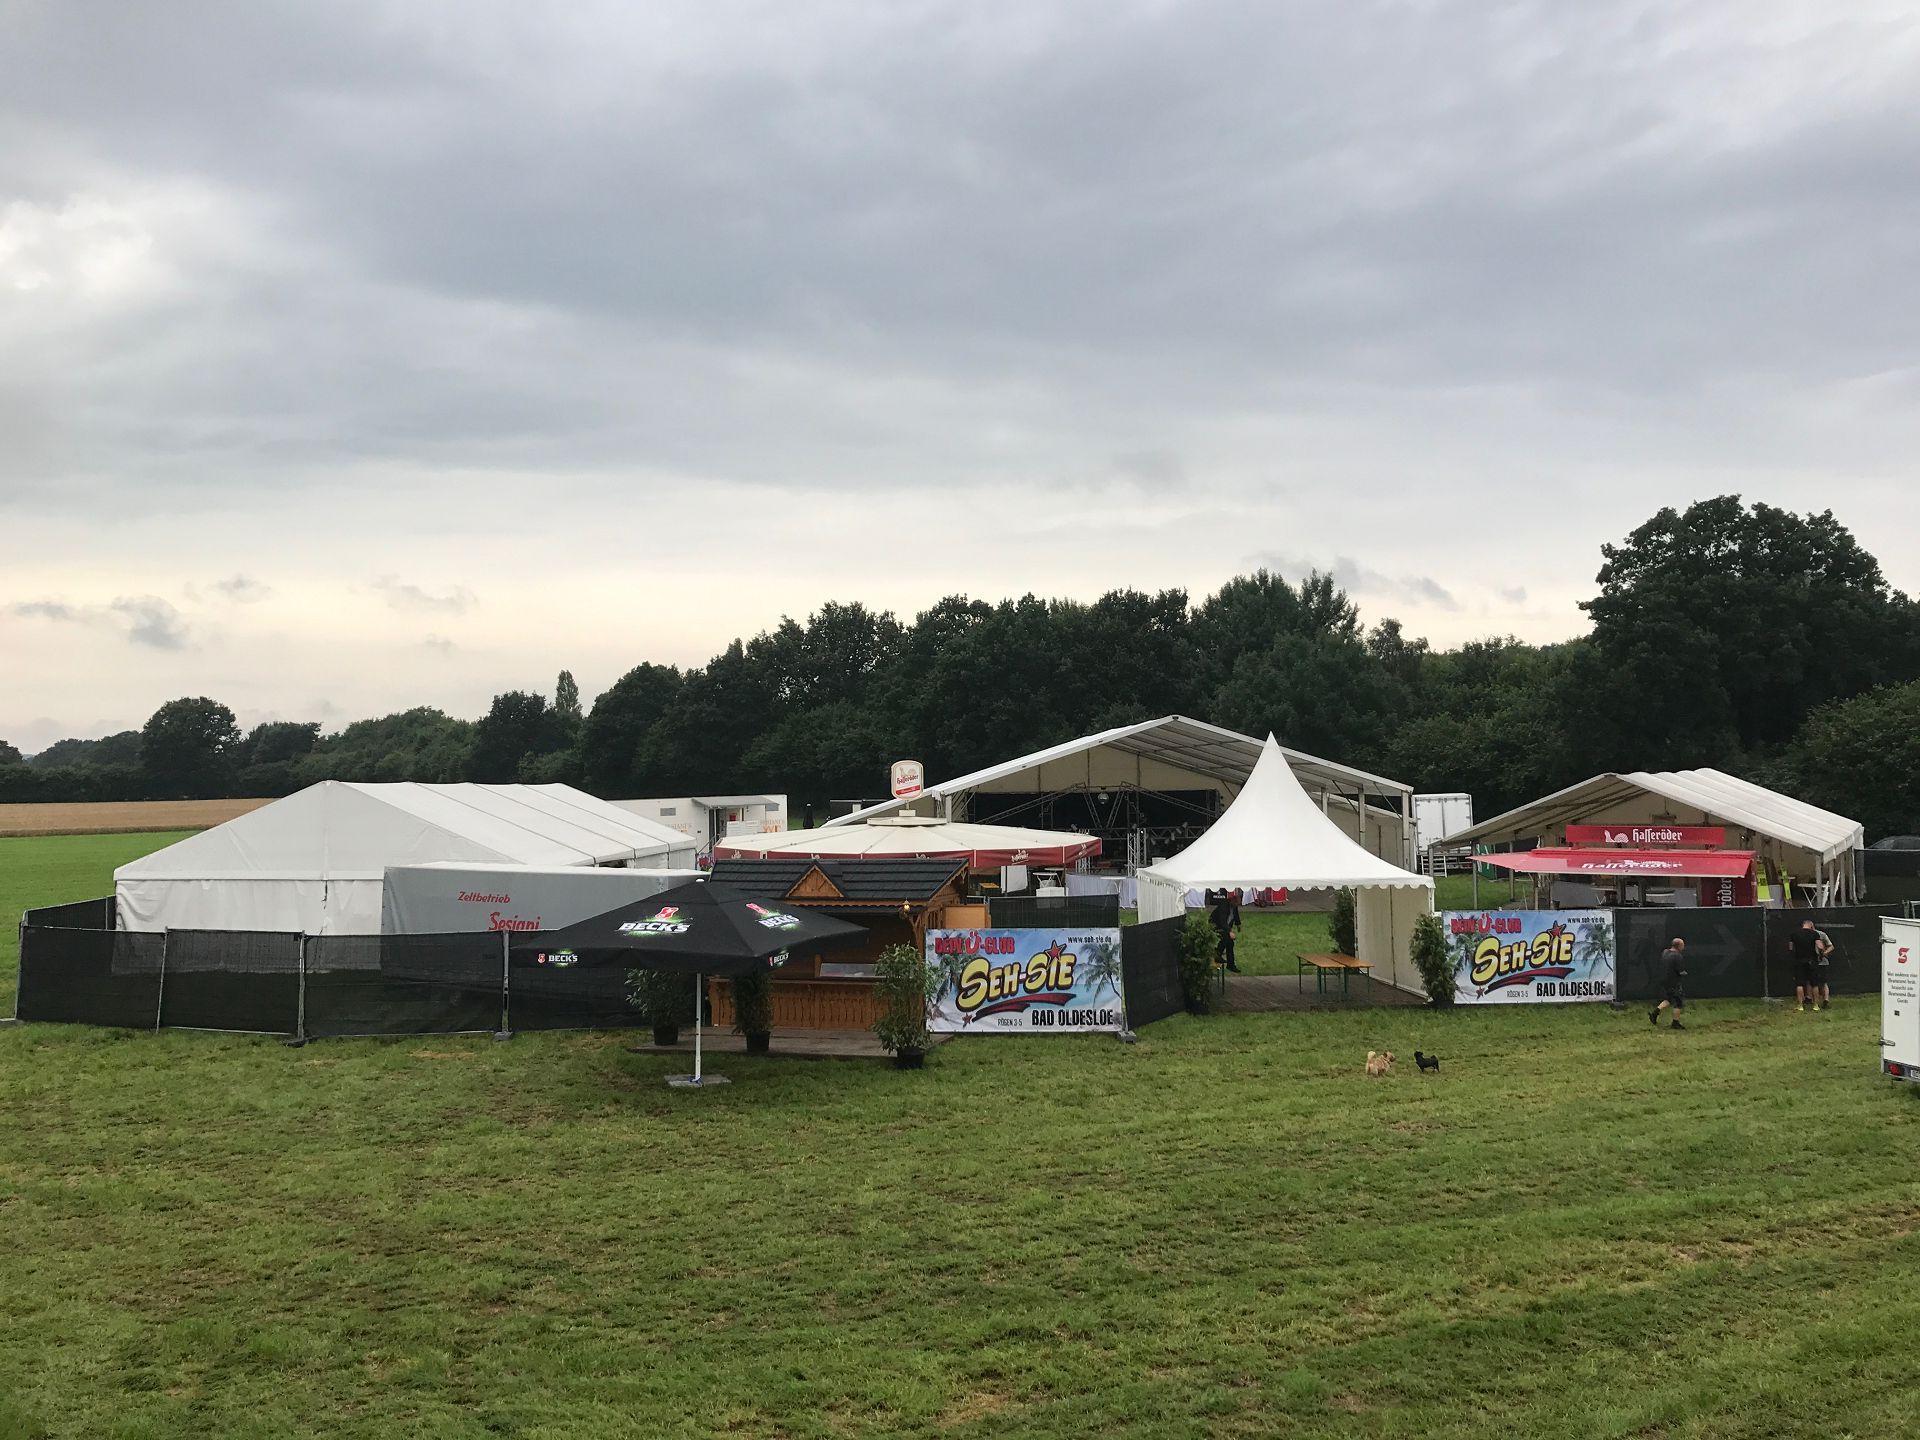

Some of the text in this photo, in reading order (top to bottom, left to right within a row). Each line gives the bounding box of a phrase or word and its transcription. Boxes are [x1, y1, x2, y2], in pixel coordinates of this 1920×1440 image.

[457, 891, 511, 904] Zeltbetrieb
[617, 922, 691, 933] BECK'S
[548, 953, 579, 962] BECK'S
[1536, 981, 1606, 997] BAD OLDESLOE
[1032, 1008, 1114, 1026] BAD OLDESLOE
